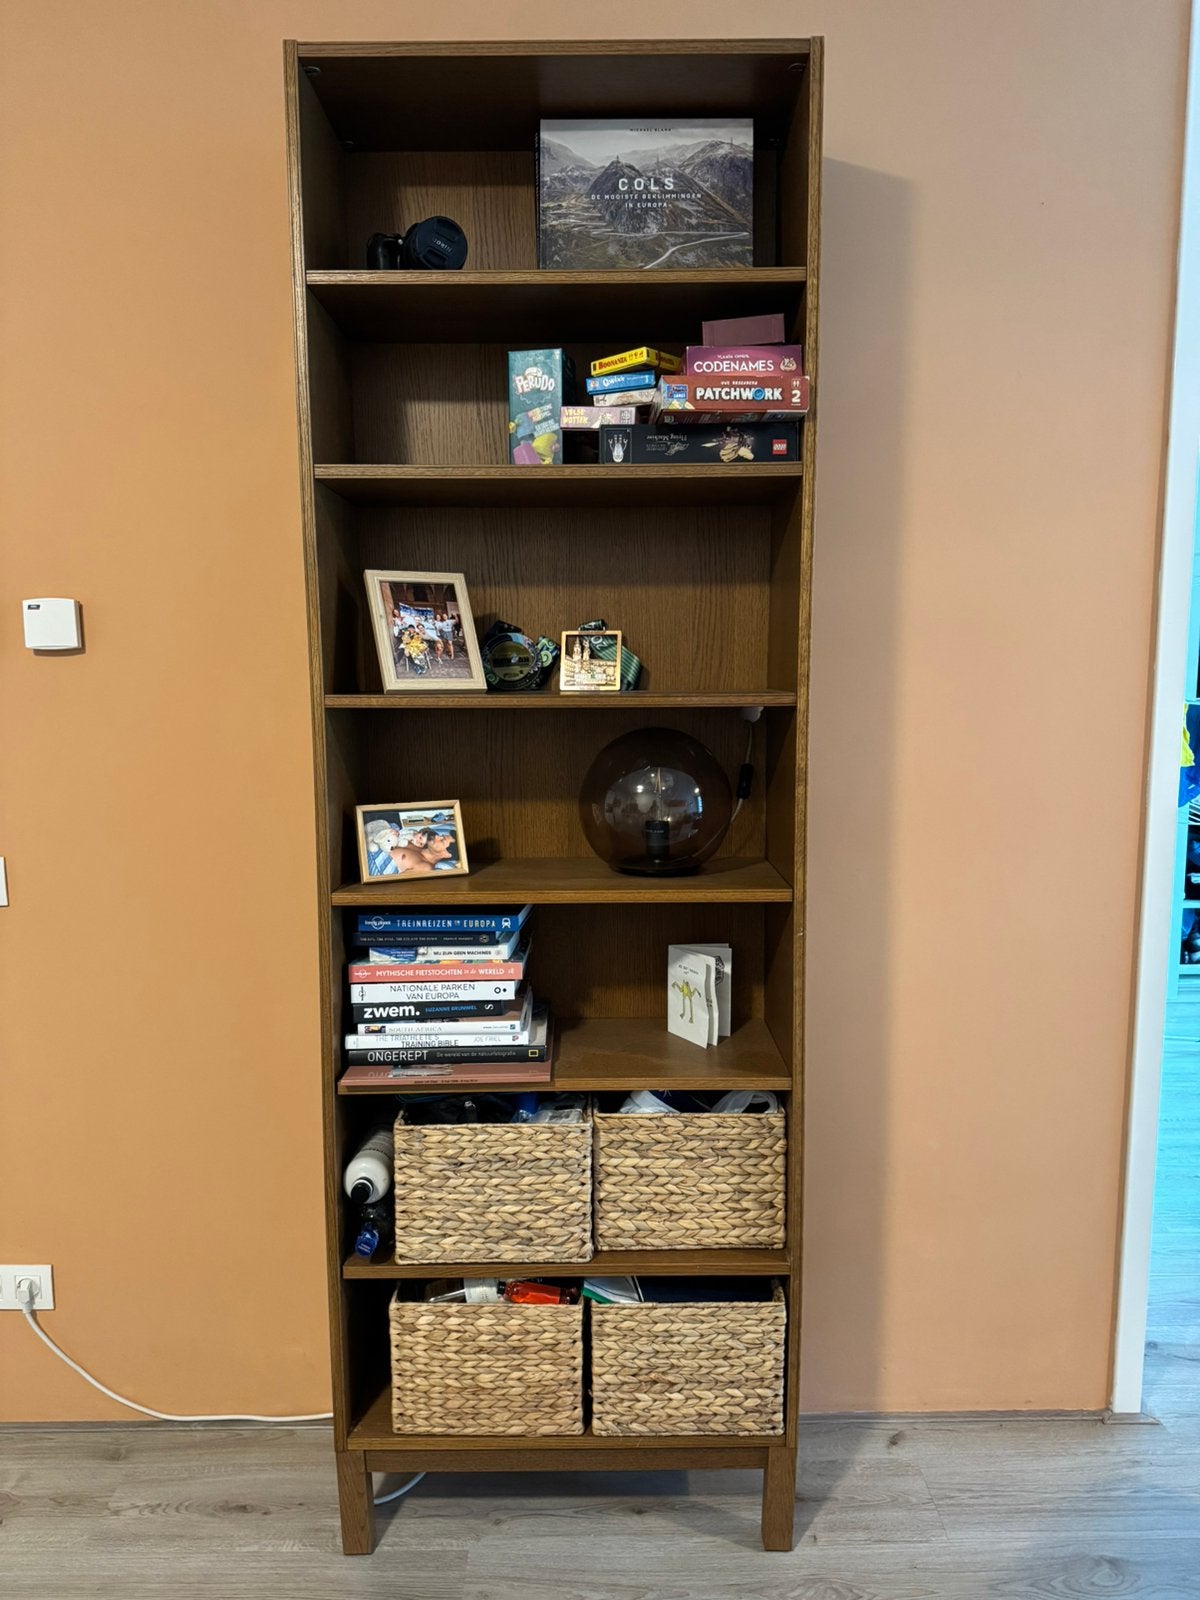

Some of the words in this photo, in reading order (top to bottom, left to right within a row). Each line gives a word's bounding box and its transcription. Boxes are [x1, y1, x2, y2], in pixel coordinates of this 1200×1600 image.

[618, 178, 675, 192] COLS
[693, 360, 774, 373] CODENAMES
[515, 374, 555, 393] PERUDO
[695, 387, 783, 401] PATCHWORK
[791, 389, 802, 403] 2
[396, 919, 452, 928] TREINREIZEN
[463, 919, 496, 928] EUROPA
[376, 969, 414, 977] MYTHISCHE
[389, 984, 438, 992] NATIONALE
[441, 983, 475, 991] PARKEN
[405, 992, 424, 1000] VAN
[425, 992, 460, 1000] EUROPA
[363, 1004, 421, 1019] zwem.
[388, 1026, 416, 1034] SOUTH
[401, 1040, 436, 1048] TRAINING
[437, 1039, 460, 1047] BIBLE
[367, 1050, 429, 1062] ONGEREPT
